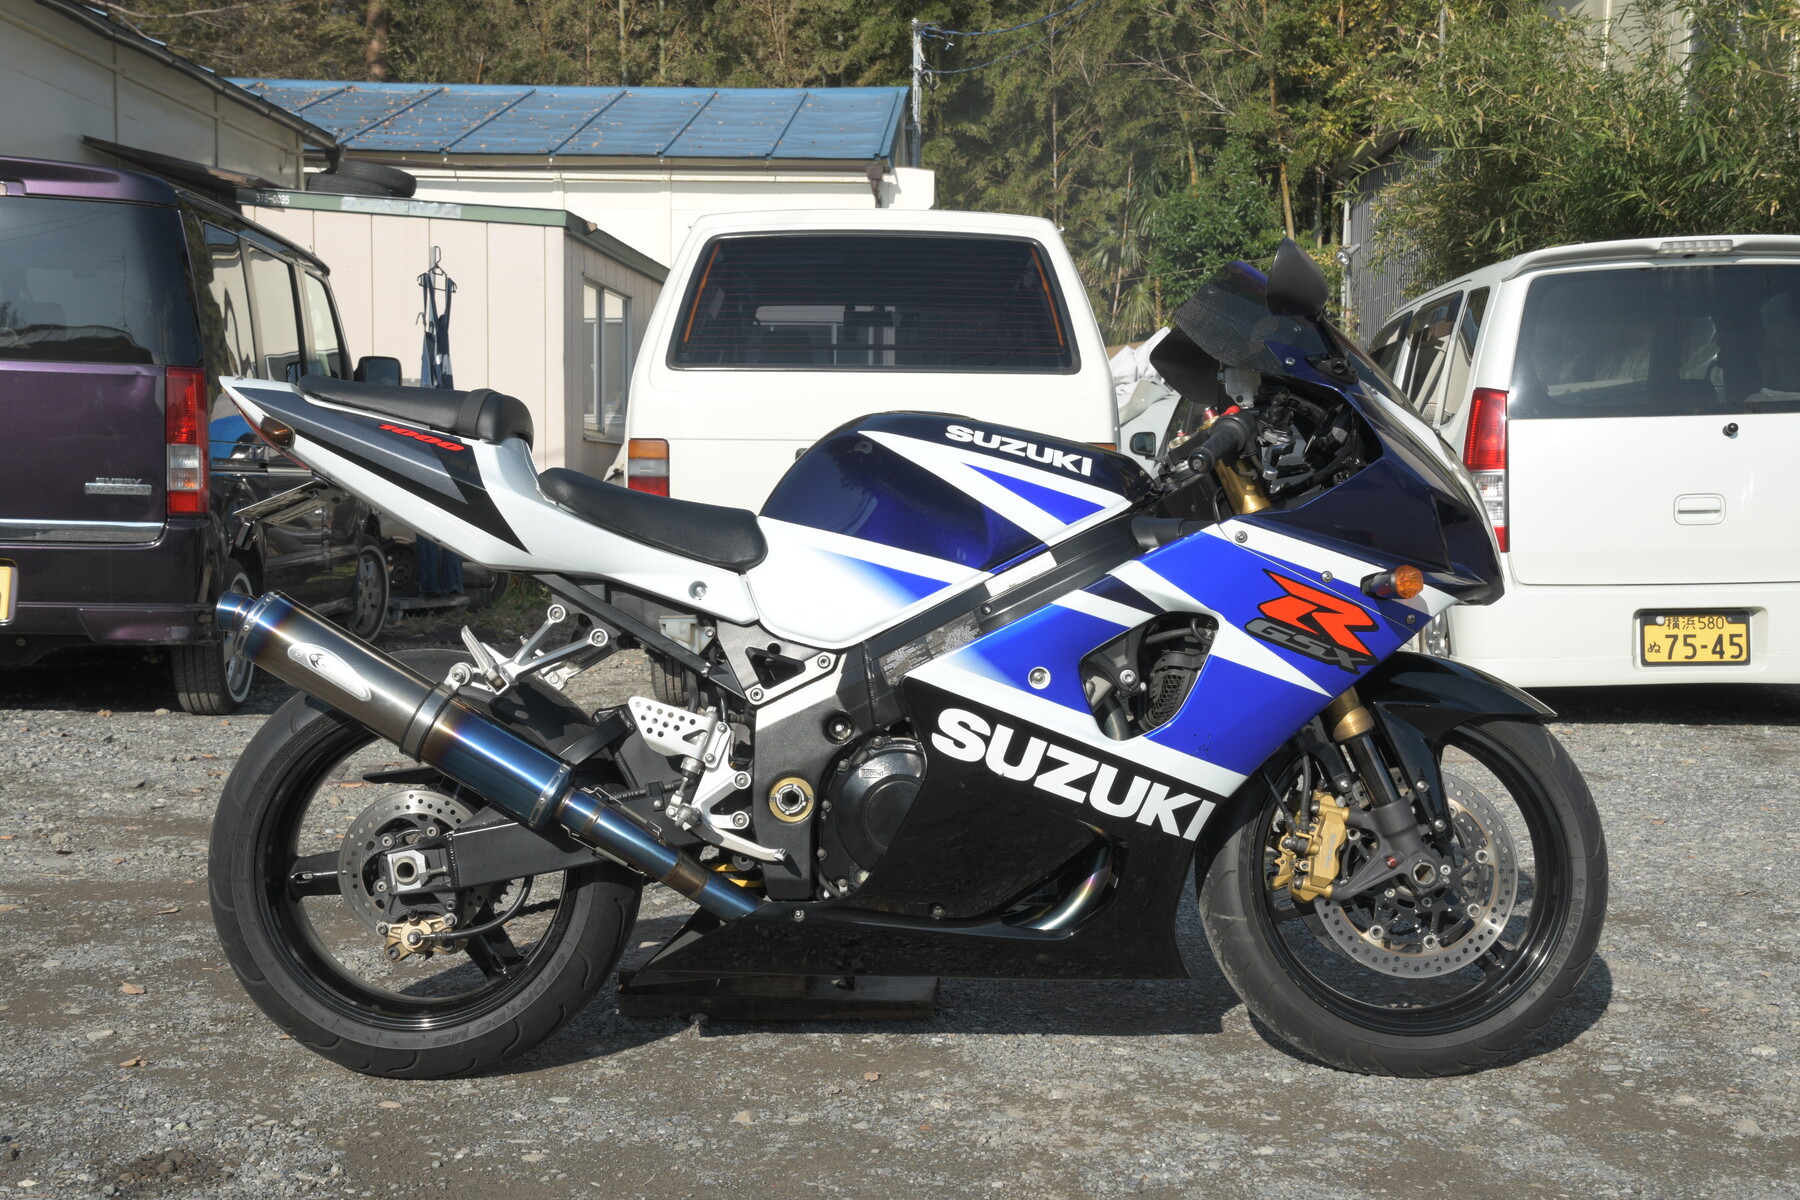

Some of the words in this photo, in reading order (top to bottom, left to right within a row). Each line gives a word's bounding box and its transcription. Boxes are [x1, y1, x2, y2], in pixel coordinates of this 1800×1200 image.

[378, 423, 465, 451] 1000
[945, 424, 1093, 477] SUZUKI
[1244, 617, 1371, 671] GSX
[1664, 633, 1744, 660] 75-45
[931, 708, 1216, 842] SUZUKI
[1539, 897, 1585, 987] METZELER
